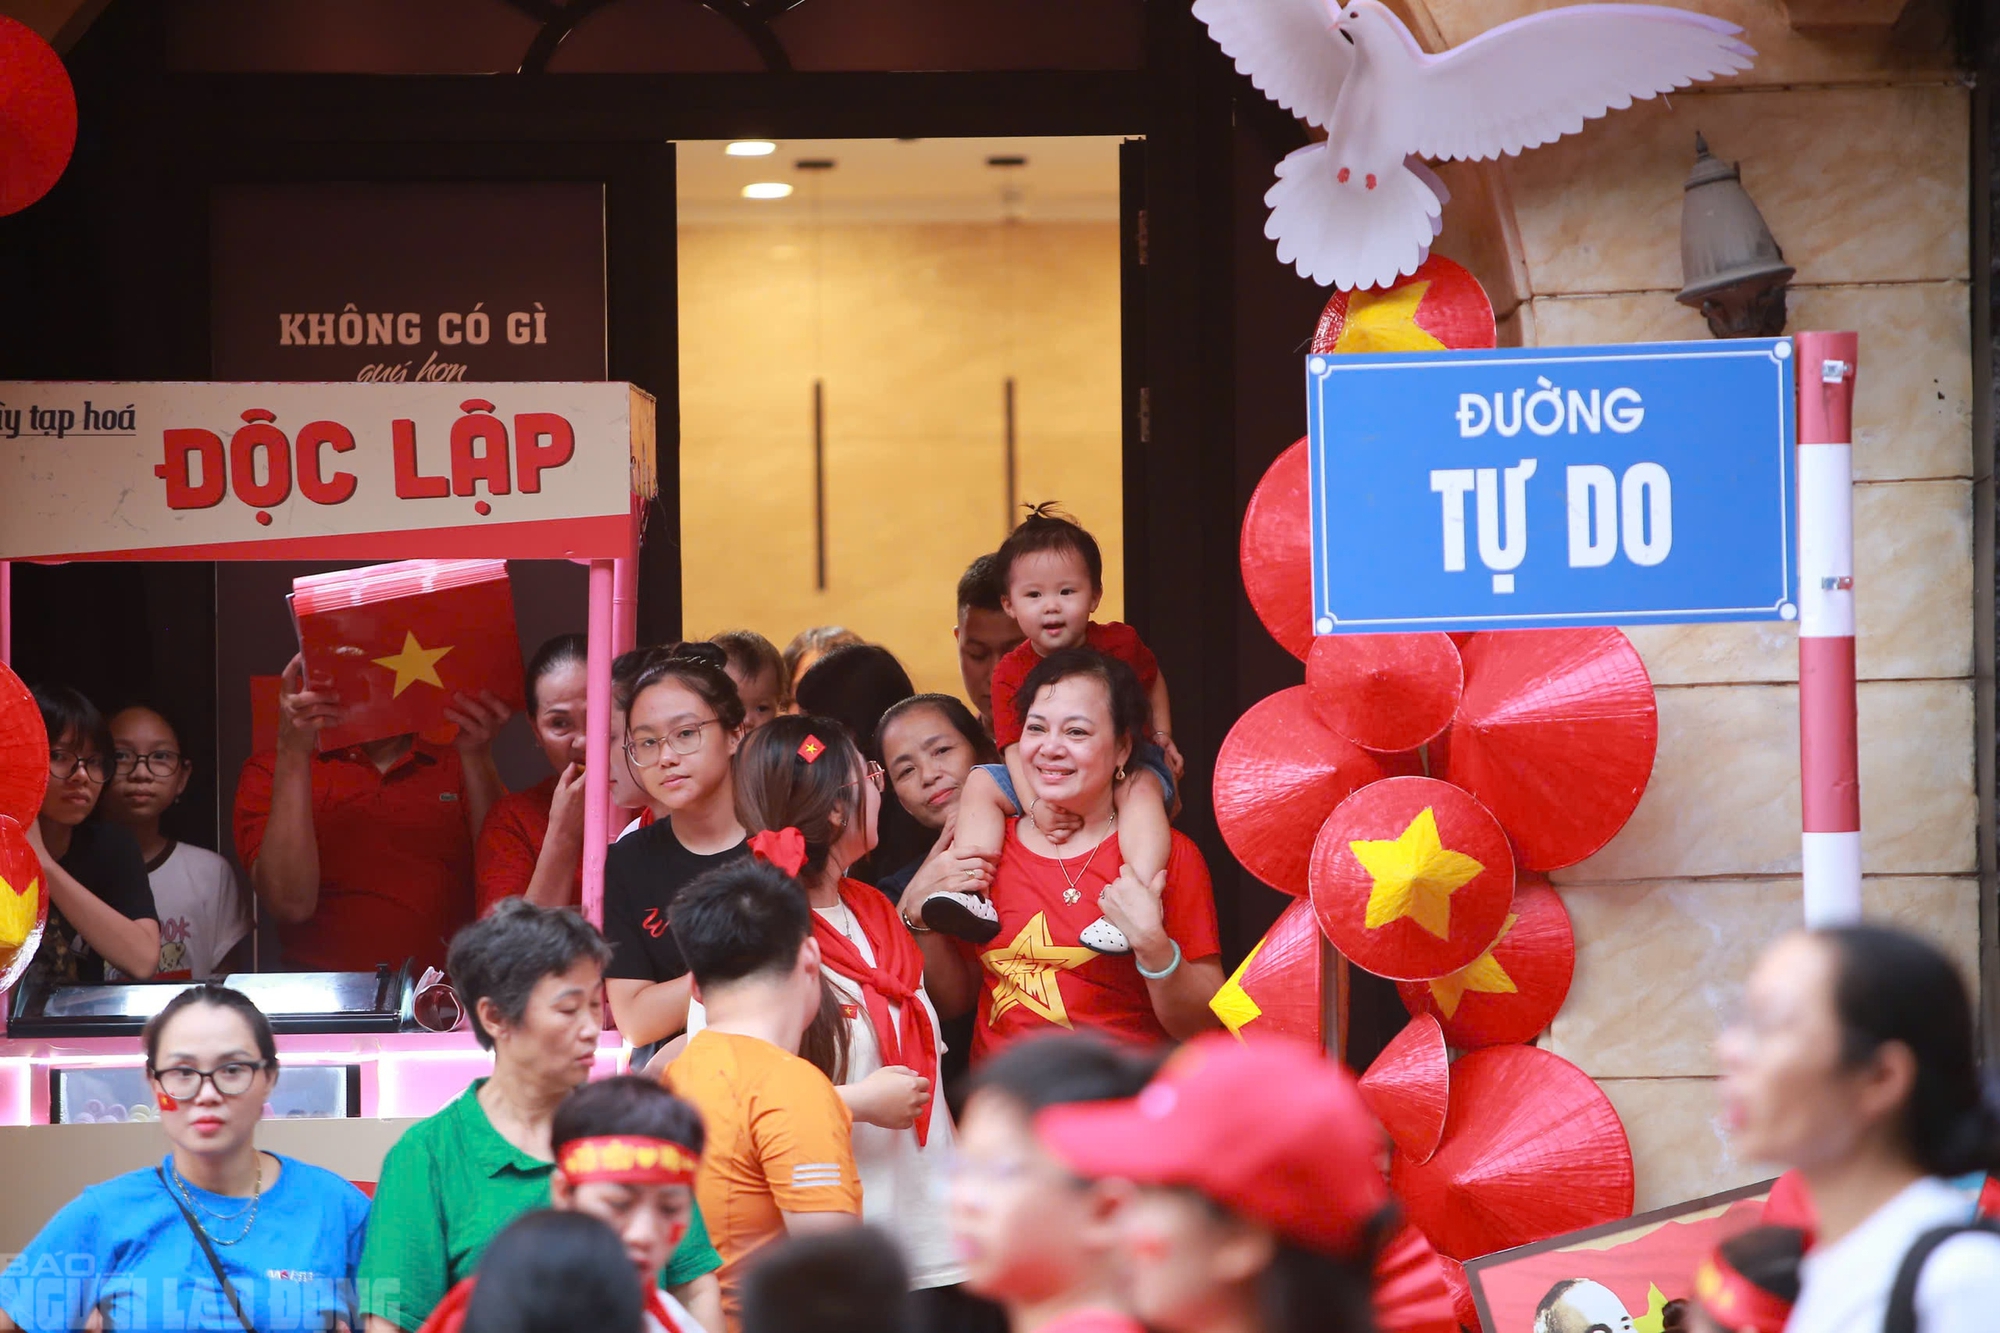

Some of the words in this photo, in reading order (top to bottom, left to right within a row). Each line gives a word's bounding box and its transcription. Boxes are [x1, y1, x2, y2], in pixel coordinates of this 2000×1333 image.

[279, 303, 422, 346] KHÔNG
[438, 302, 491, 345] CÓ
[507, 302, 547, 345] GÌ
[29, 405, 75, 439] tạp
[83, 401, 136, 431] hoá
[1456, 376, 1645, 438] ĐƯỜNG
[154, 408, 358, 526] ĐỘC
[392, 399, 575, 516] LẬP
[1430, 458, 1538, 594] TỰ
[1566, 462, 1673, 568] DO
